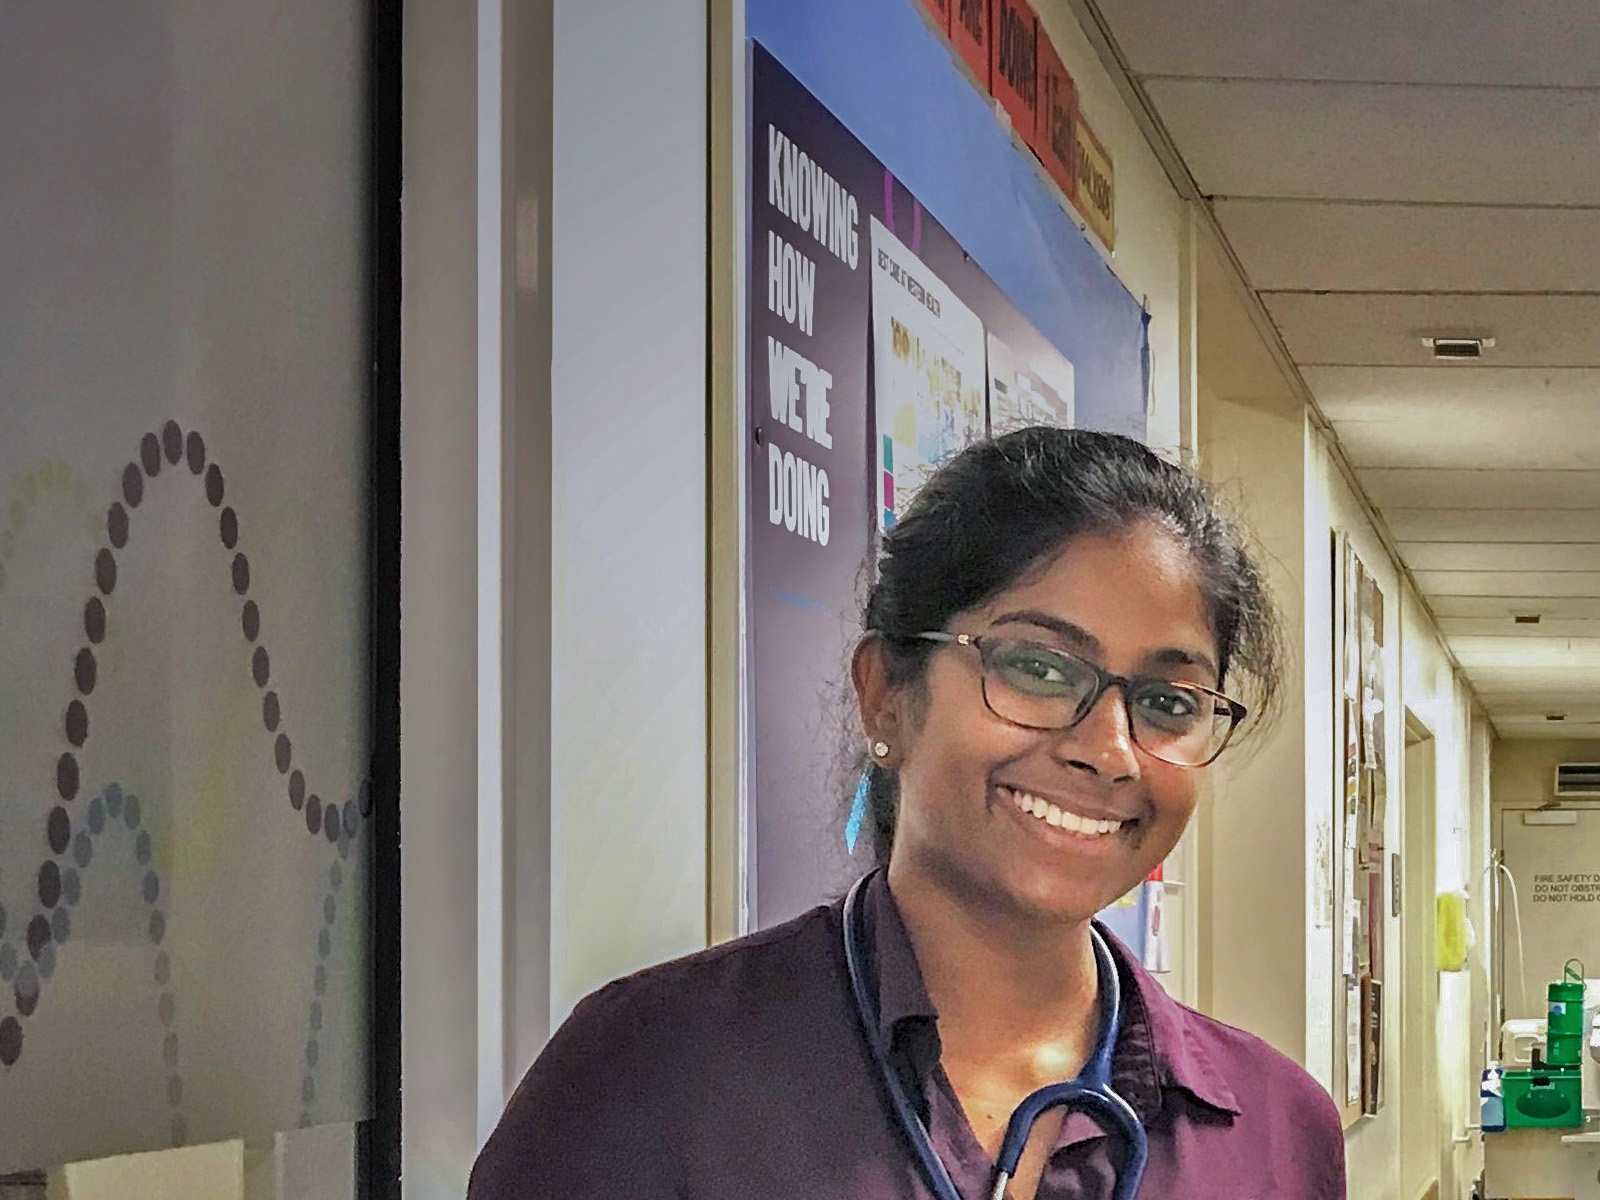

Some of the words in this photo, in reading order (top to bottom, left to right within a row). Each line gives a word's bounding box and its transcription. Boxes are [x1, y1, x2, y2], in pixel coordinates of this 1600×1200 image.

[769, 123, 858, 270] KNOWING
[769, 230, 815, 337] HOW
[769, 443, 829, 547] DOING
[1533, 894, 1547, 902] DO
[1548, 894, 1568, 902] NOT
[1569, 894, 1595, 902] HOLD
[1534, 874, 1554, 882] FIRE
[1557, 874, 1592, 882] SAFETY
[1535, 884, 1549, 892] DO
[1550, 884, 1569, 892] NOT
